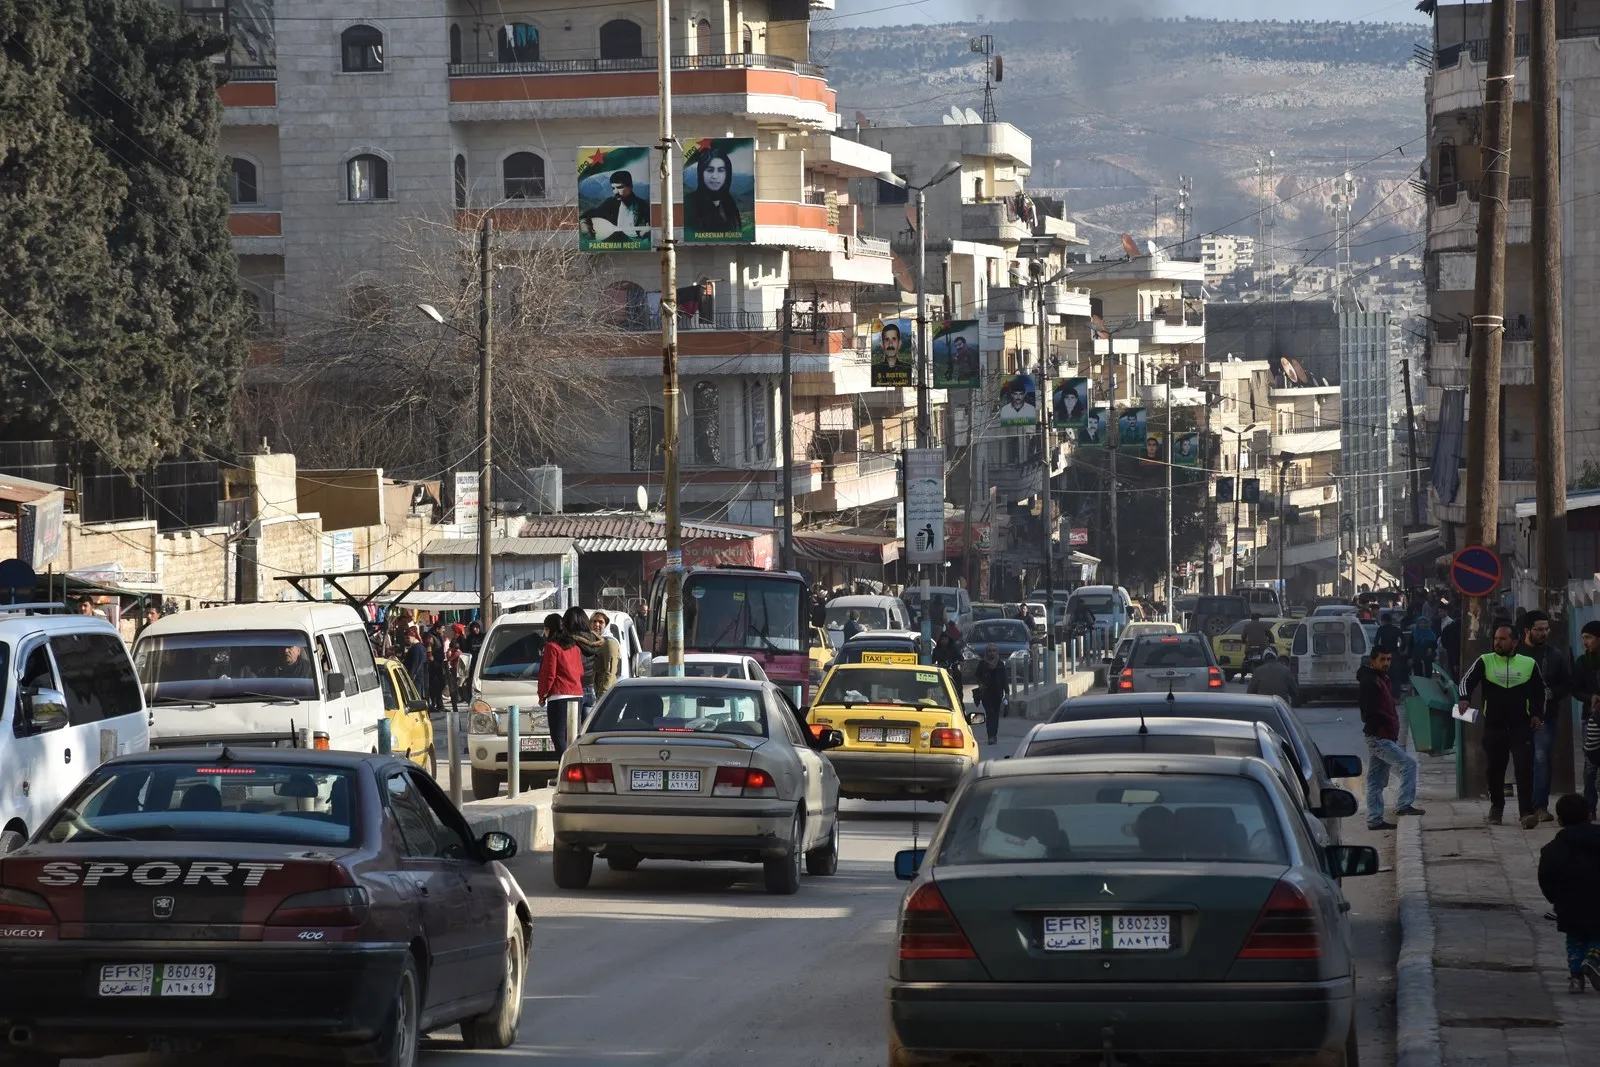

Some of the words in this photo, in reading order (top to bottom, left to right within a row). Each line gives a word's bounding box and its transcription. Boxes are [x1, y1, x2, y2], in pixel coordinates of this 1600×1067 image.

[633, 771, 656, 779] EFR
[672, 772, 698, 780] 861984
[37, 861, 284, 886] SPORT
[1046, 918, 1086, 932] EFR
[1118, 917, 1168, 930] 880239
[298, 931, 324, 939] 406
[1046, 935, 1086, 949] عفرين
[102, 965, 140, 980] EFR
[168, 965, 214, 980] 860492
[101, 982, 138, 994] عفرين
